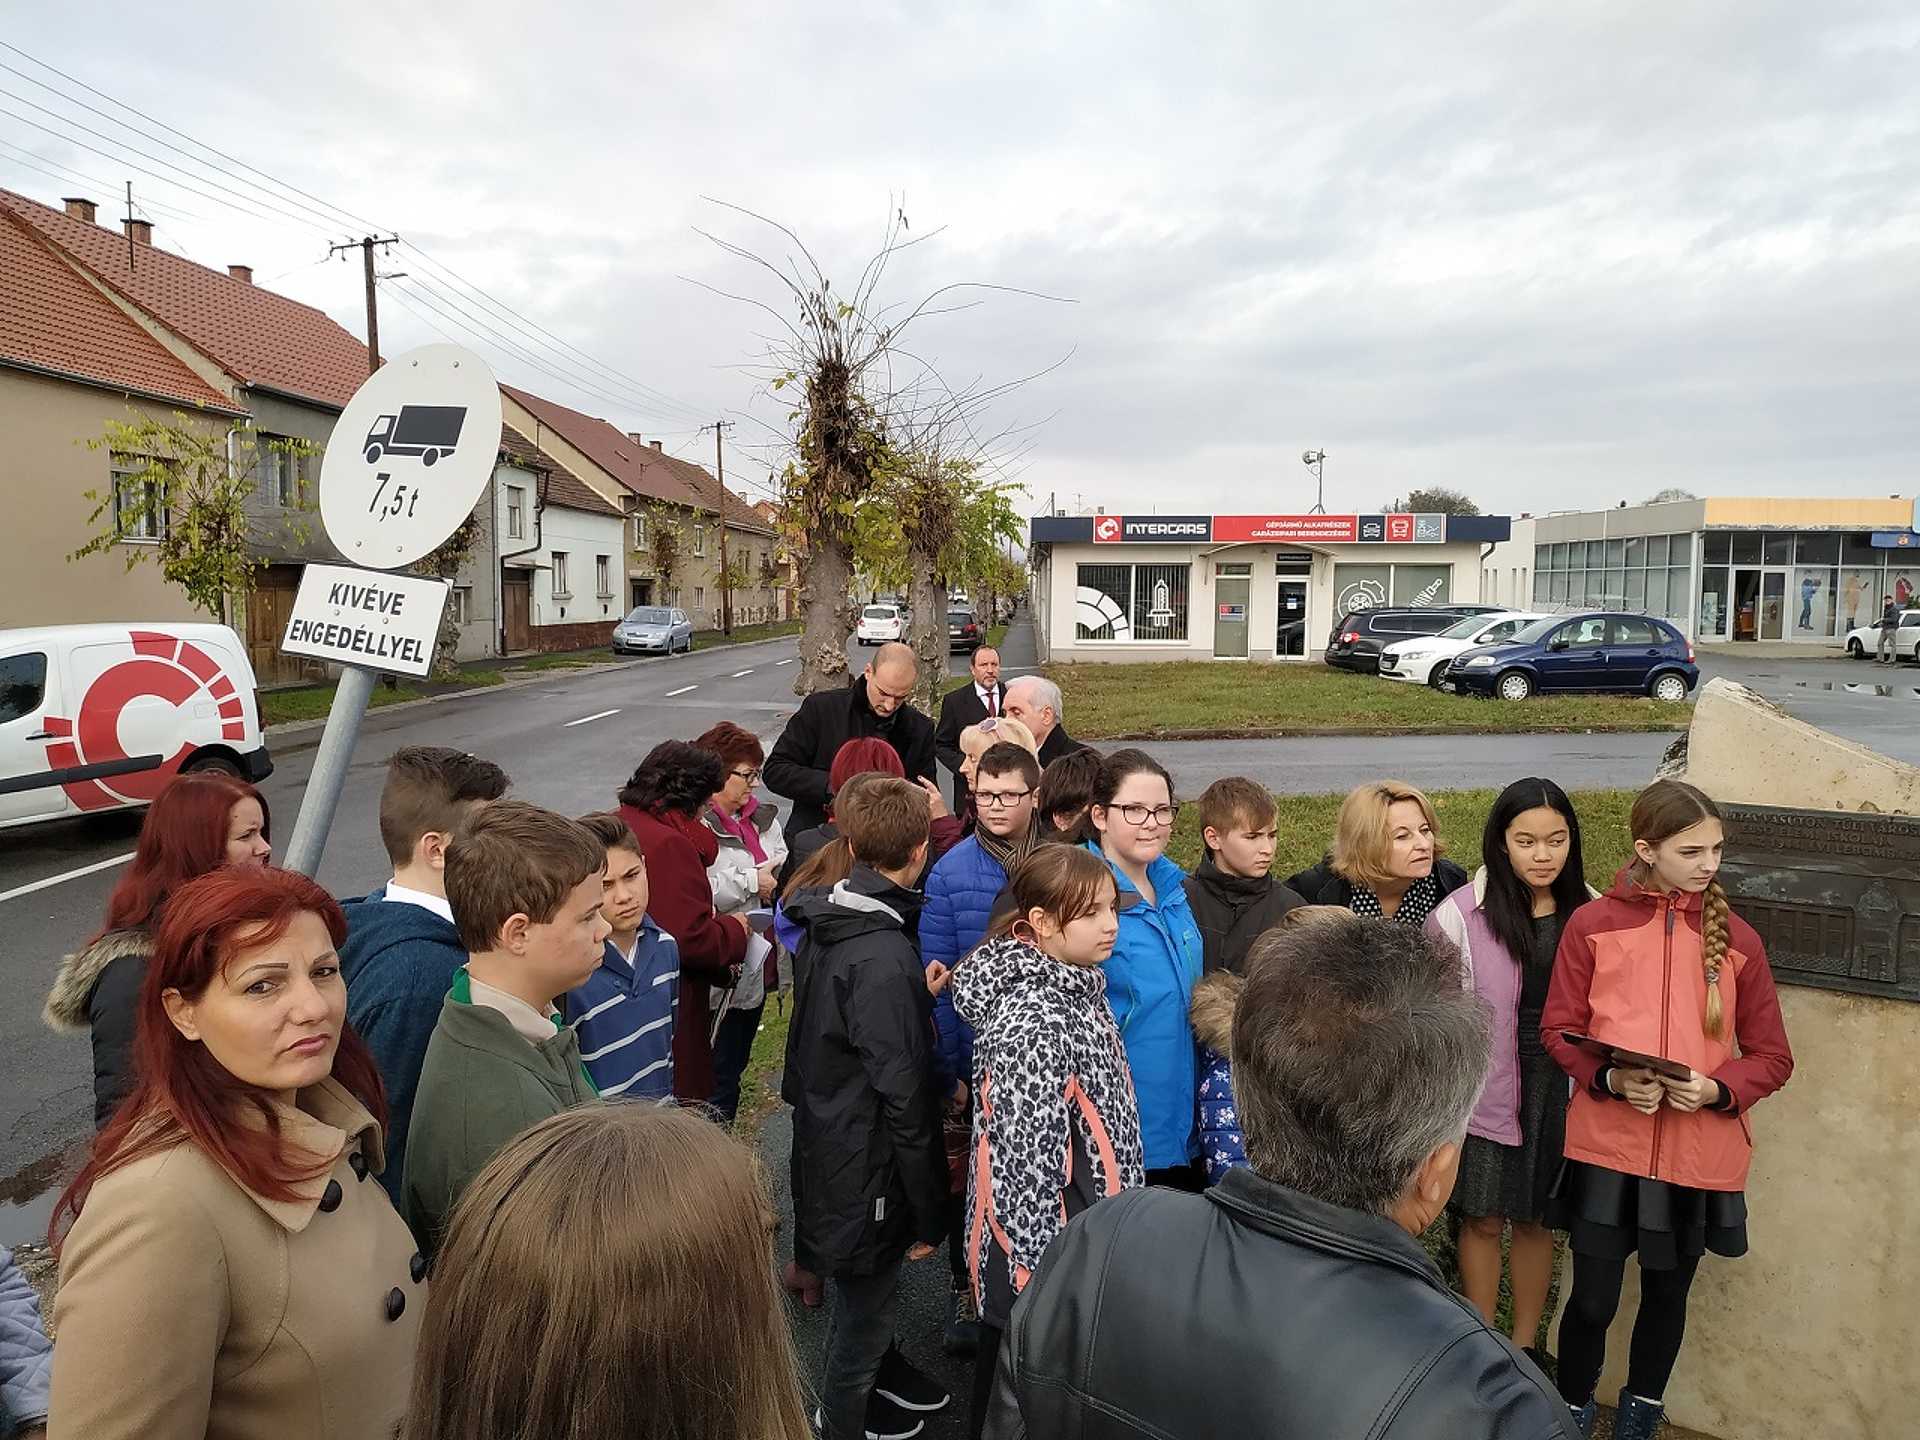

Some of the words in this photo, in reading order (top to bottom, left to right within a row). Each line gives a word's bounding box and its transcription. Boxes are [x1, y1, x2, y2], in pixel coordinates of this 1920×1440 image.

[1126, 523, 1207, 535] INTERCARS
[327, 583, 405, 616] KIVÉVE
[289, 619, 424, 663] ENGEDÉLLYEL
